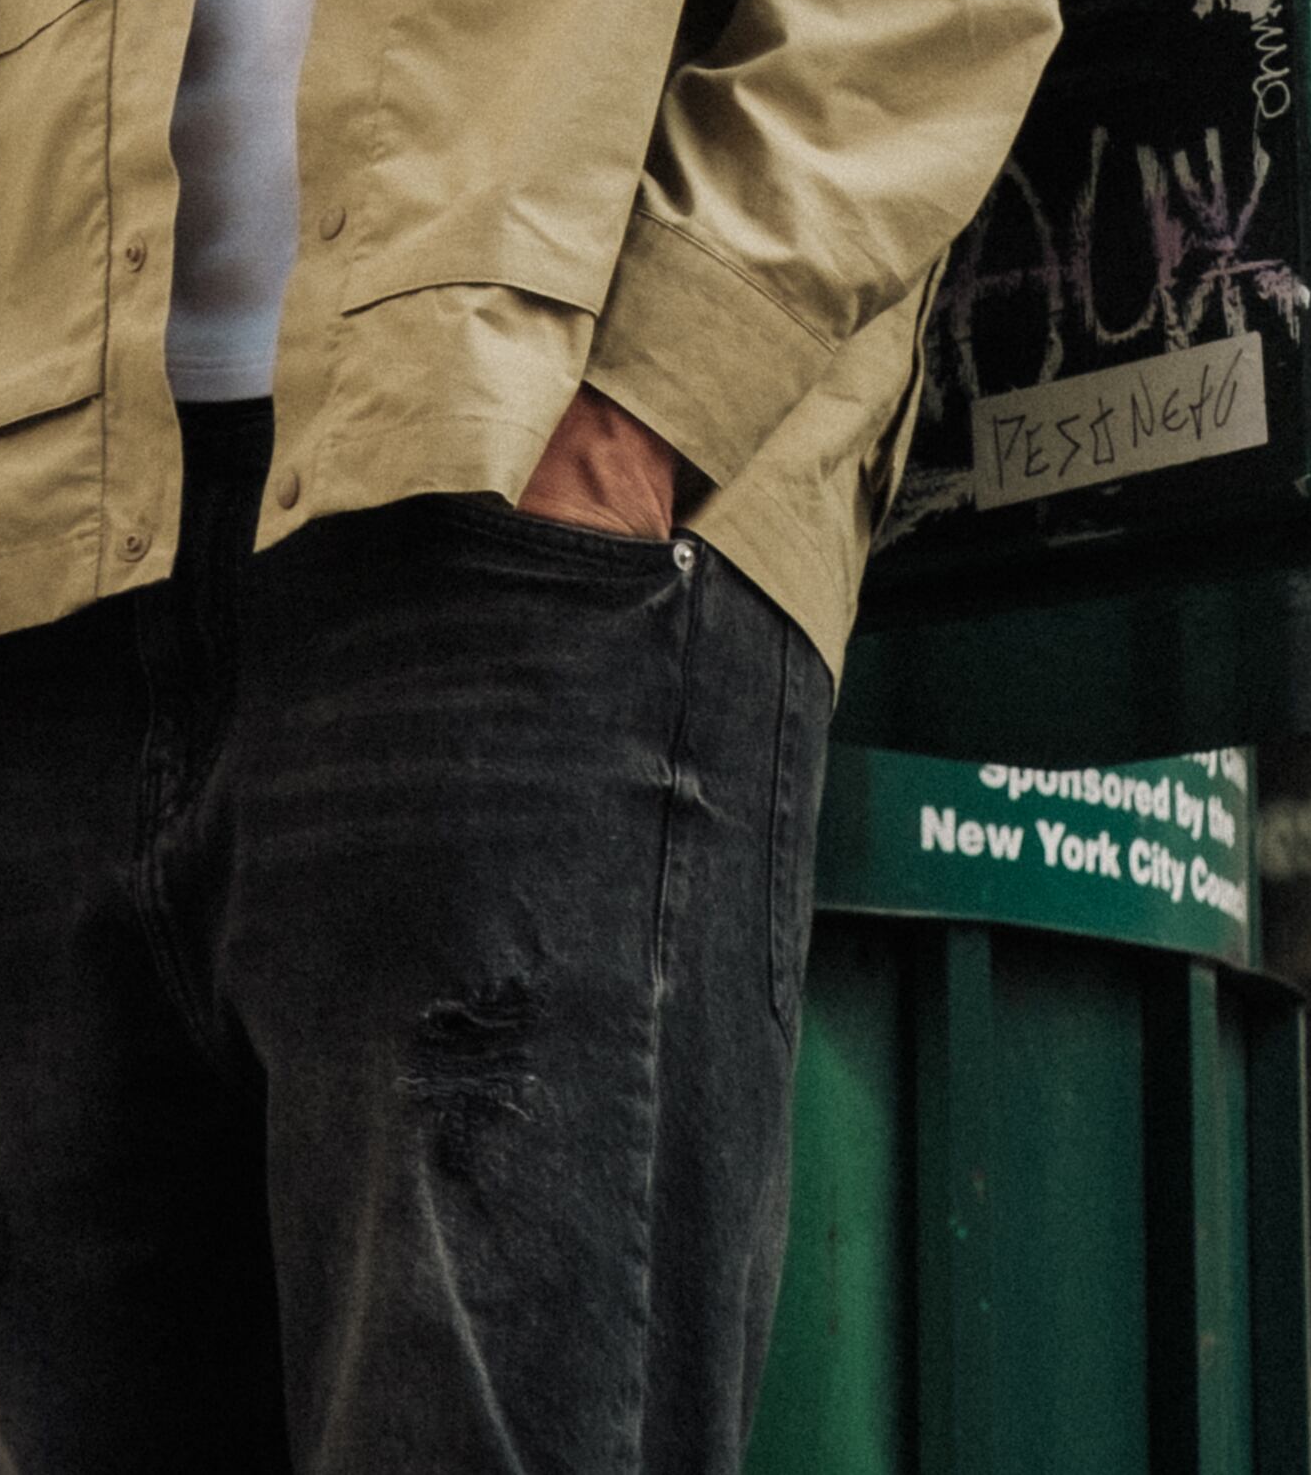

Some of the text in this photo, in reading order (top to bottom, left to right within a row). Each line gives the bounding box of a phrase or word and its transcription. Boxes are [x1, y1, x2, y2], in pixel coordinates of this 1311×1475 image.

[1174, 780, 1204, 842] by
[920, 805, 1024, 862] New
[1035, 818, 1122, 880] York
[1128, 837, 1187, 904] City
